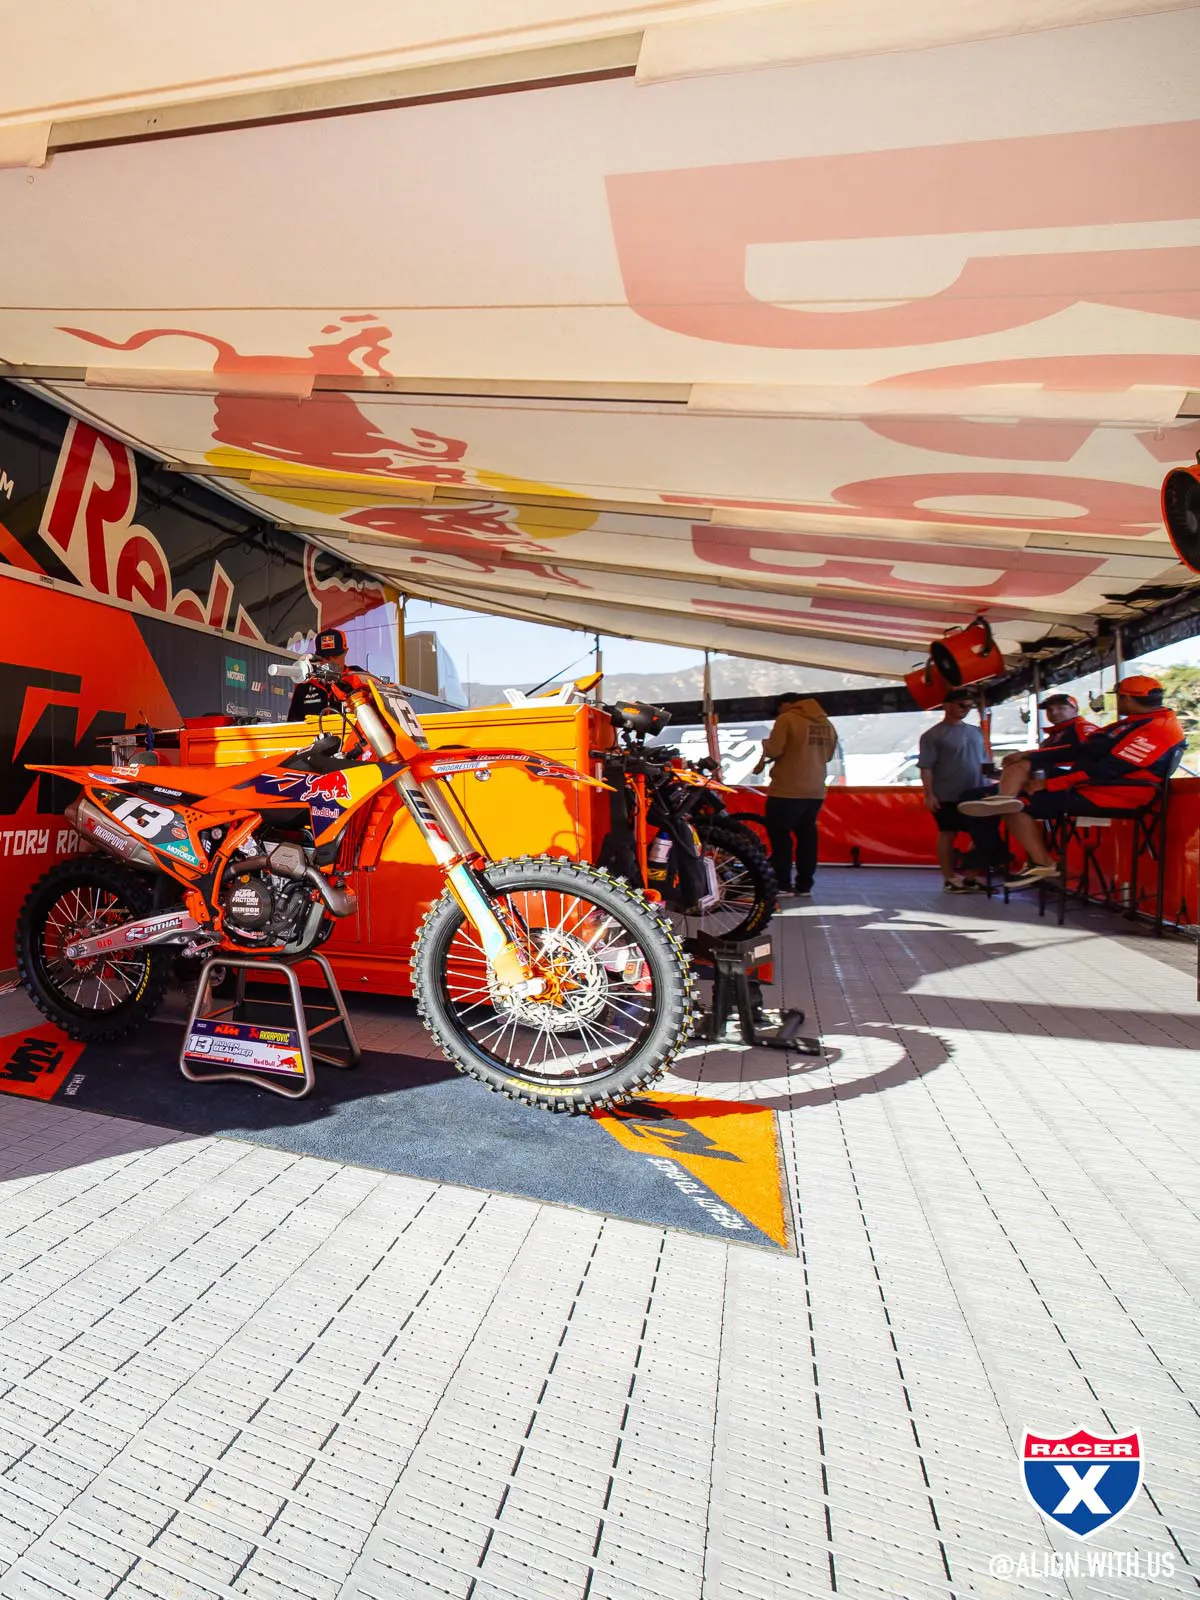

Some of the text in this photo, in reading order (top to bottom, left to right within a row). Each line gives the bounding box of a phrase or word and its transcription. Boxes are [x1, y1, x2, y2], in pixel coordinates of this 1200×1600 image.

[112, 797, 175, 839] 13
[166, 844, 196, 864] MOTOREX
[189, 1035, 214, 1054] 13
